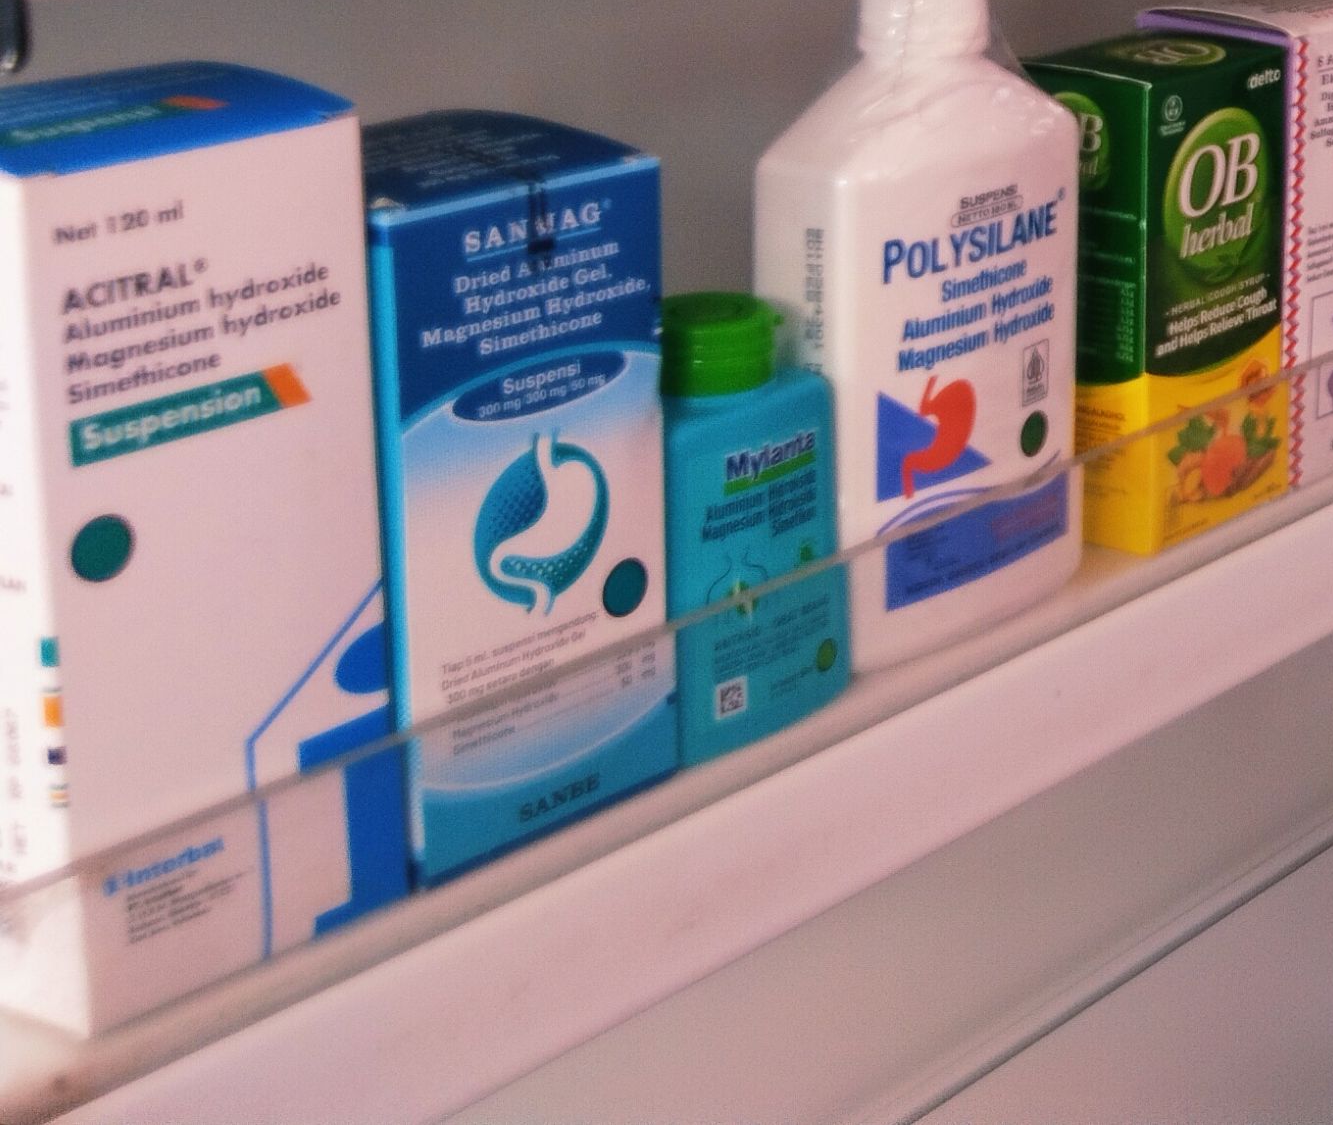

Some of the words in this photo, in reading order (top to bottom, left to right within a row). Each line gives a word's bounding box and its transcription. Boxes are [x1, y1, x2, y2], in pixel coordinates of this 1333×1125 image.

[1177, 132, 1261, 219] OB
[883, 198, 1058, 285] POLYSILANE
[1179, 202, 1256, 259] herbal
[62, 262, 193, 315] ACITRAL
[64, 295, 200, 343] Aluminium
[208, 262, 330, 311] hydroxide
[454, 264, 512, 295] Dried
[464, 273, 570, 315] Hydroxide
[941, 259, 1028, 303] Simethicone
[66, 325, 215, 374] Magnesium
[221, 287, 342, 337] hydroxide
[421, 301, 542, 348] Magnesium
[478, 311, 603, 356] Simethicone
[902, 301, 987, 342] Aluminium
[991, 274, 1054, 318] Hydroxide
[1155, 338, 1178, 358] and
[1179, 325, 1208, 349] Helps
[1208, 312, 1245, 335] Relieve
[1246, 298, 1278, 321] Throat
[1168, 311, 1199, 335] Helps
[1200, 299, 1236, 324] Reduce
[1237, 286, 1268, 310] Cough
[896, 330, 989, 373] Magnesium
[994, 302, 1056, 344] Hydroxide
[68, 351, 222, 405] Simethicone
[502, 359, 582, 394] Suspensi
[81, 382, 262, 450] Suspension
[725, 429, 817, 482] Mylanta
[518, 775, 600, 825] SANBE
